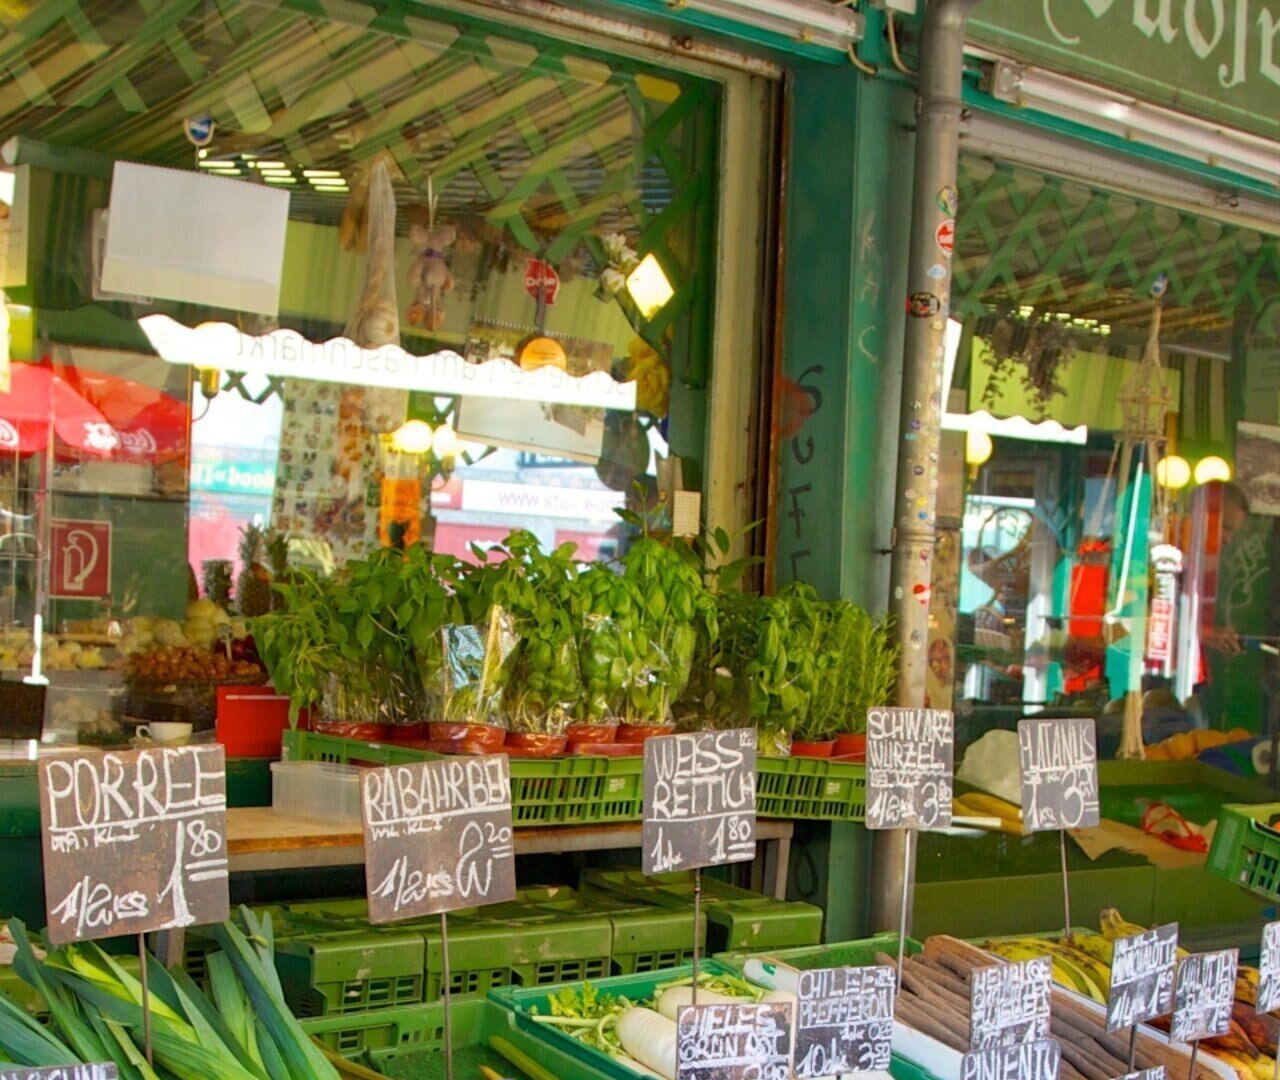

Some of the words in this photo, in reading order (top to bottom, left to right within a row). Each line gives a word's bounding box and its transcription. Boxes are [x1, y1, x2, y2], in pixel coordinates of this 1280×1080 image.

[652, 731, 744, 781] WEISS
[46, 748, 226, 831] PORREE
[651, 769, 756, 820] RETTICH
